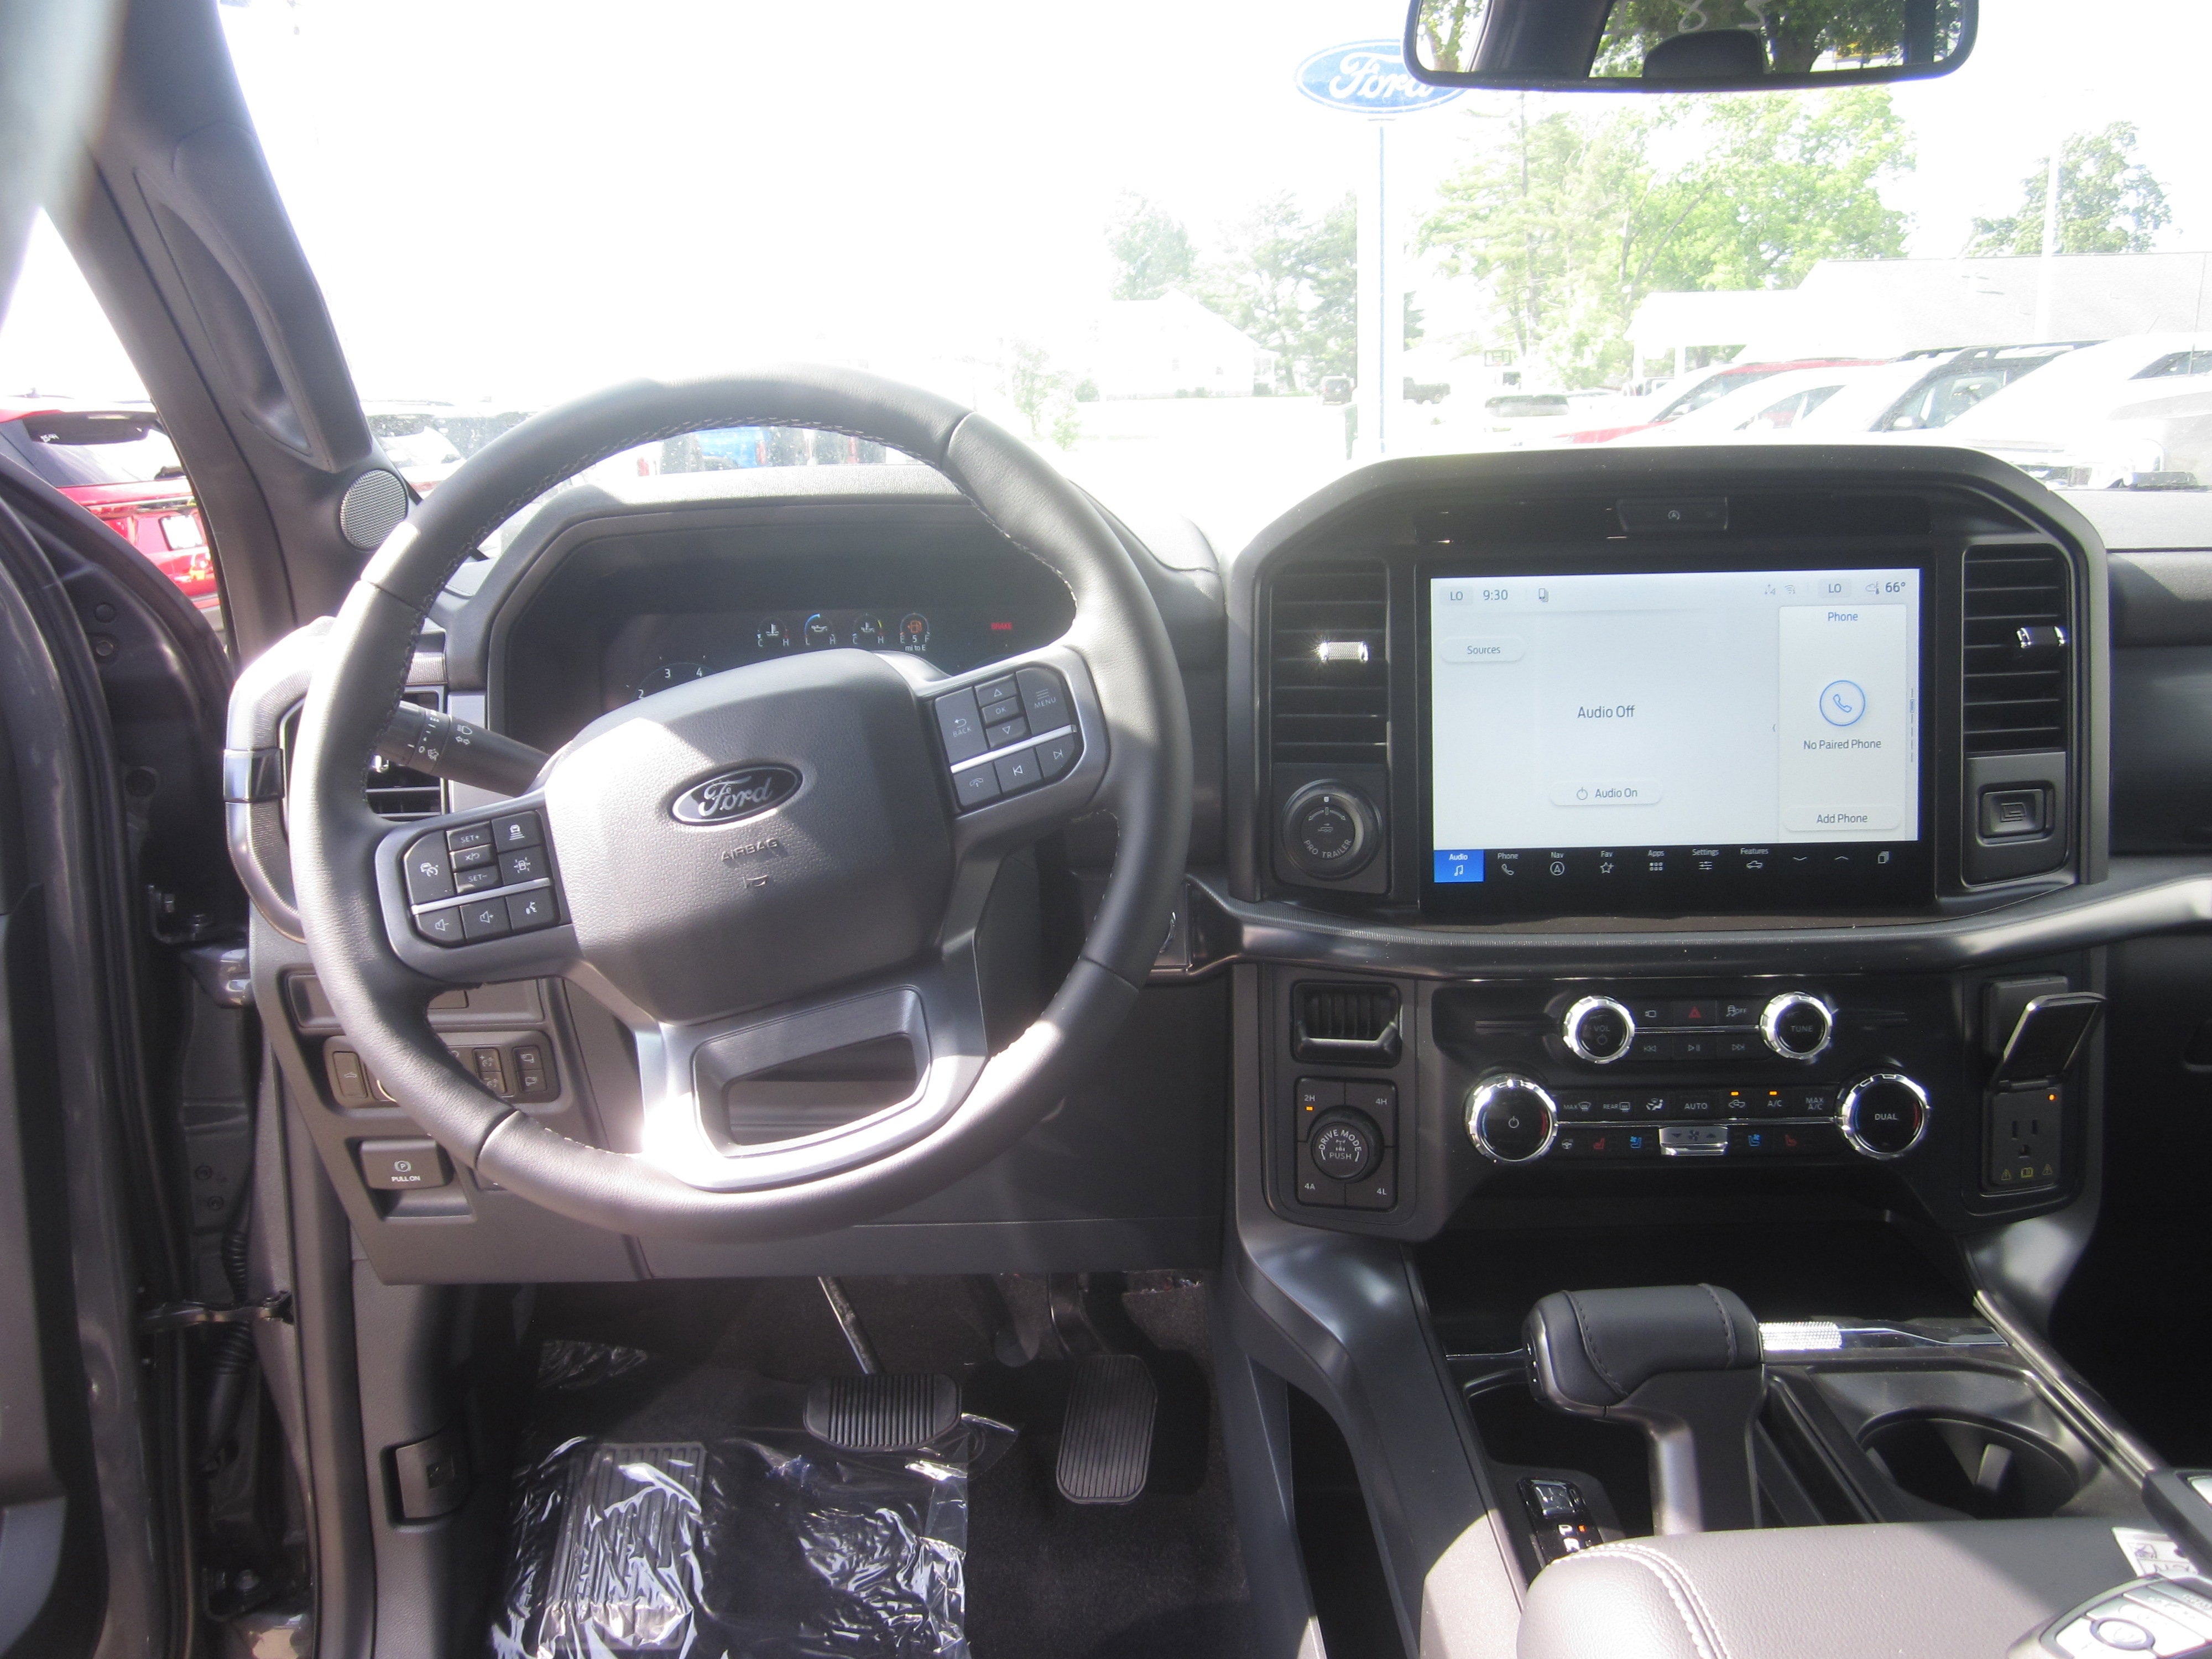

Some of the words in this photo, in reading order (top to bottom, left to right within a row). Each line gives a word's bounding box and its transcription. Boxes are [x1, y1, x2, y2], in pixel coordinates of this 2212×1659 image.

[1828, 583, 1841, 593] LO
[1450, 591, 1463, 601] LO
[1483, 589, 1509, 601] 9:30
[1828, 612, 1858, 622] Phone
[1467, 645, 1501, 655] Sources
[665, 669, 671, 678] 3
[696, 667, 702, 677] 4
[638, 689, 644, 698] 2
[1034, 697, 1056, 709] MENU
[995, 706, 1006, 714] OK
[1577, 706, 1613, 718] Audio
[1616, 705, 1635, 718] Off
[953, 726, 971, 738] BACK
[1803, 740, 1817, 749] No
[1819, 739, 1849, 749] Paired
[1851, 739, 1882, 749] Phone
[698, 776, 773, 817] Ford
[1595, 788, 1623, 798] Audio
[1624, 787, 1638, 797] On
[1816, 814, 1835, 823] Add
[1837, 813, 1868, 823] Phone
[721, 838, 778, 862] AIRBAG
[1303, 839, 1318, 855] PRO
[1322, 839, 1352, 858] TRAILER
[1692, 848, 1719, 857] Settings
[1318, 1129, 1339, 1151] DRIVE
[1340, 1130, 1362, 1152] MODE
[1558, 1524, 1573, 1536] P
